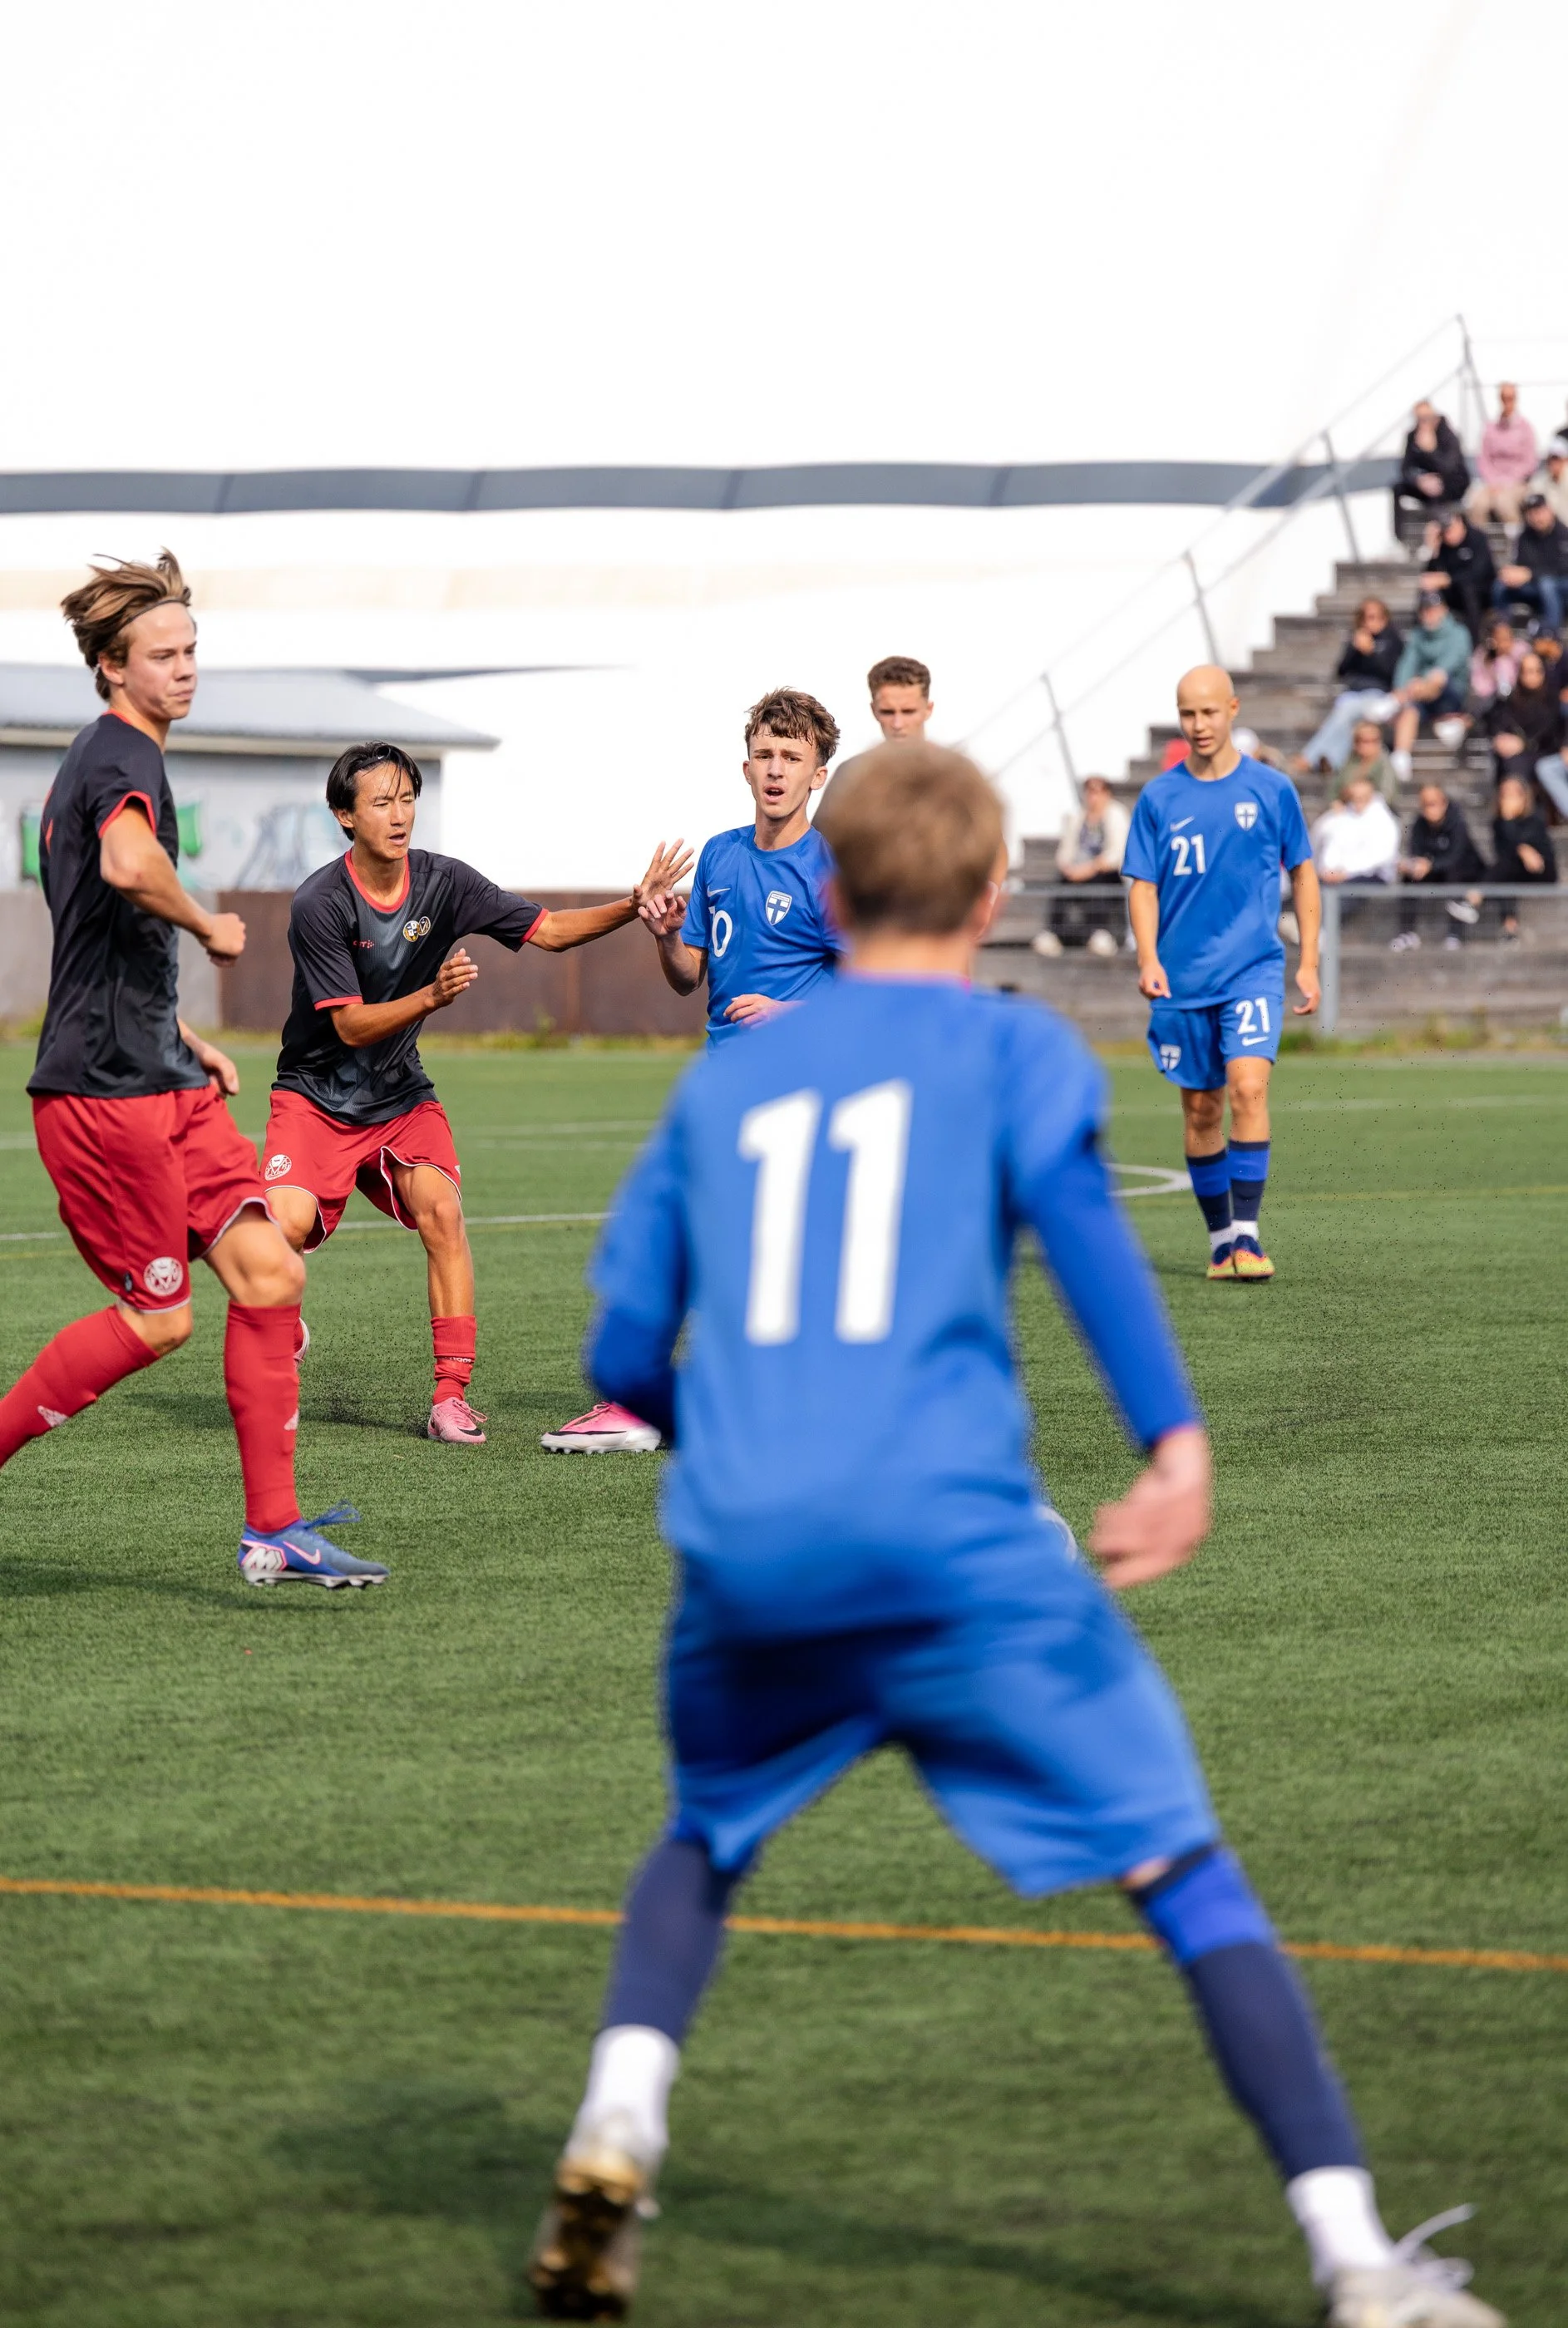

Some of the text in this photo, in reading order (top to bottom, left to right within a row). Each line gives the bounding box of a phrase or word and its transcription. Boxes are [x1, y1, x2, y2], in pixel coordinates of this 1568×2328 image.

[1171, 833, 1206, 877] 21
[1235, 997, 1271, 1035] 21
[737, 1078, 913, 1346] 11
